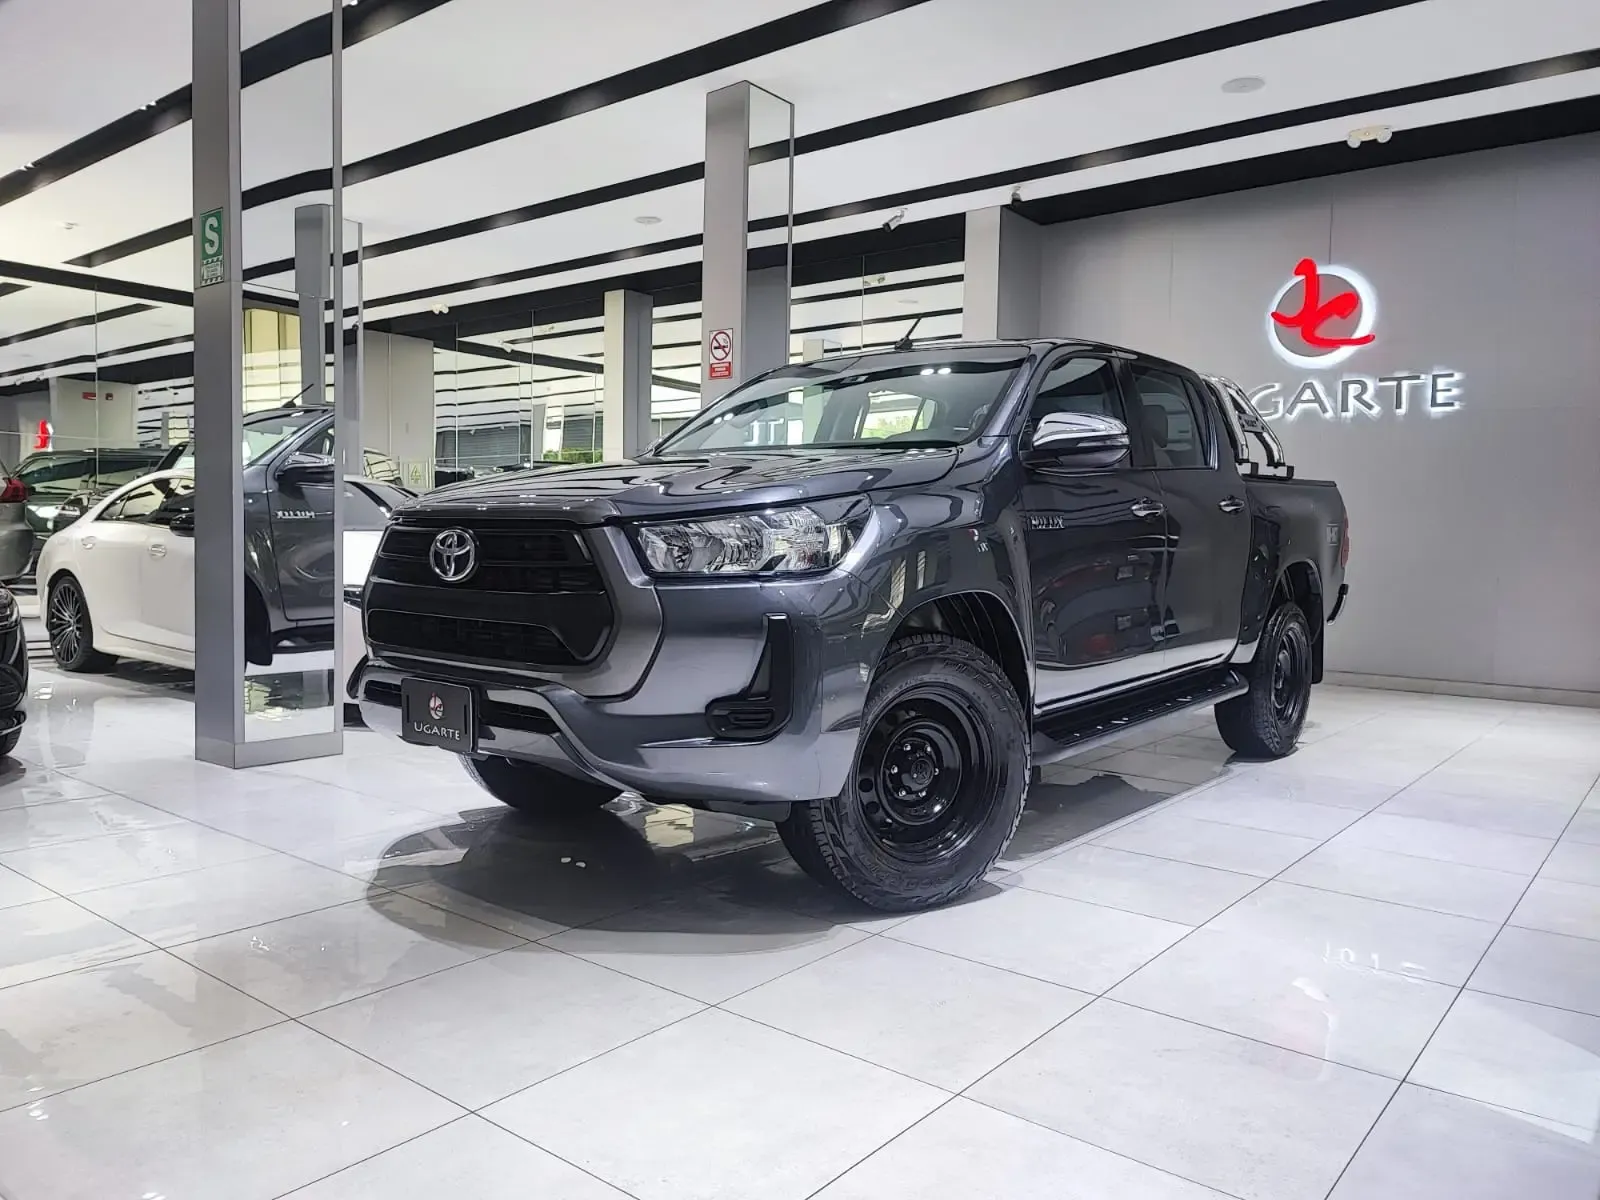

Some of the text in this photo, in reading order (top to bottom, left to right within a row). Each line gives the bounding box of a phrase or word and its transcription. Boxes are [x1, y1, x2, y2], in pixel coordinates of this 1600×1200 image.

[204, 216, 220, 255] S
[1247, 371, 1462, 421] GARTE
[413, 721, 461, 741] UGARTE
